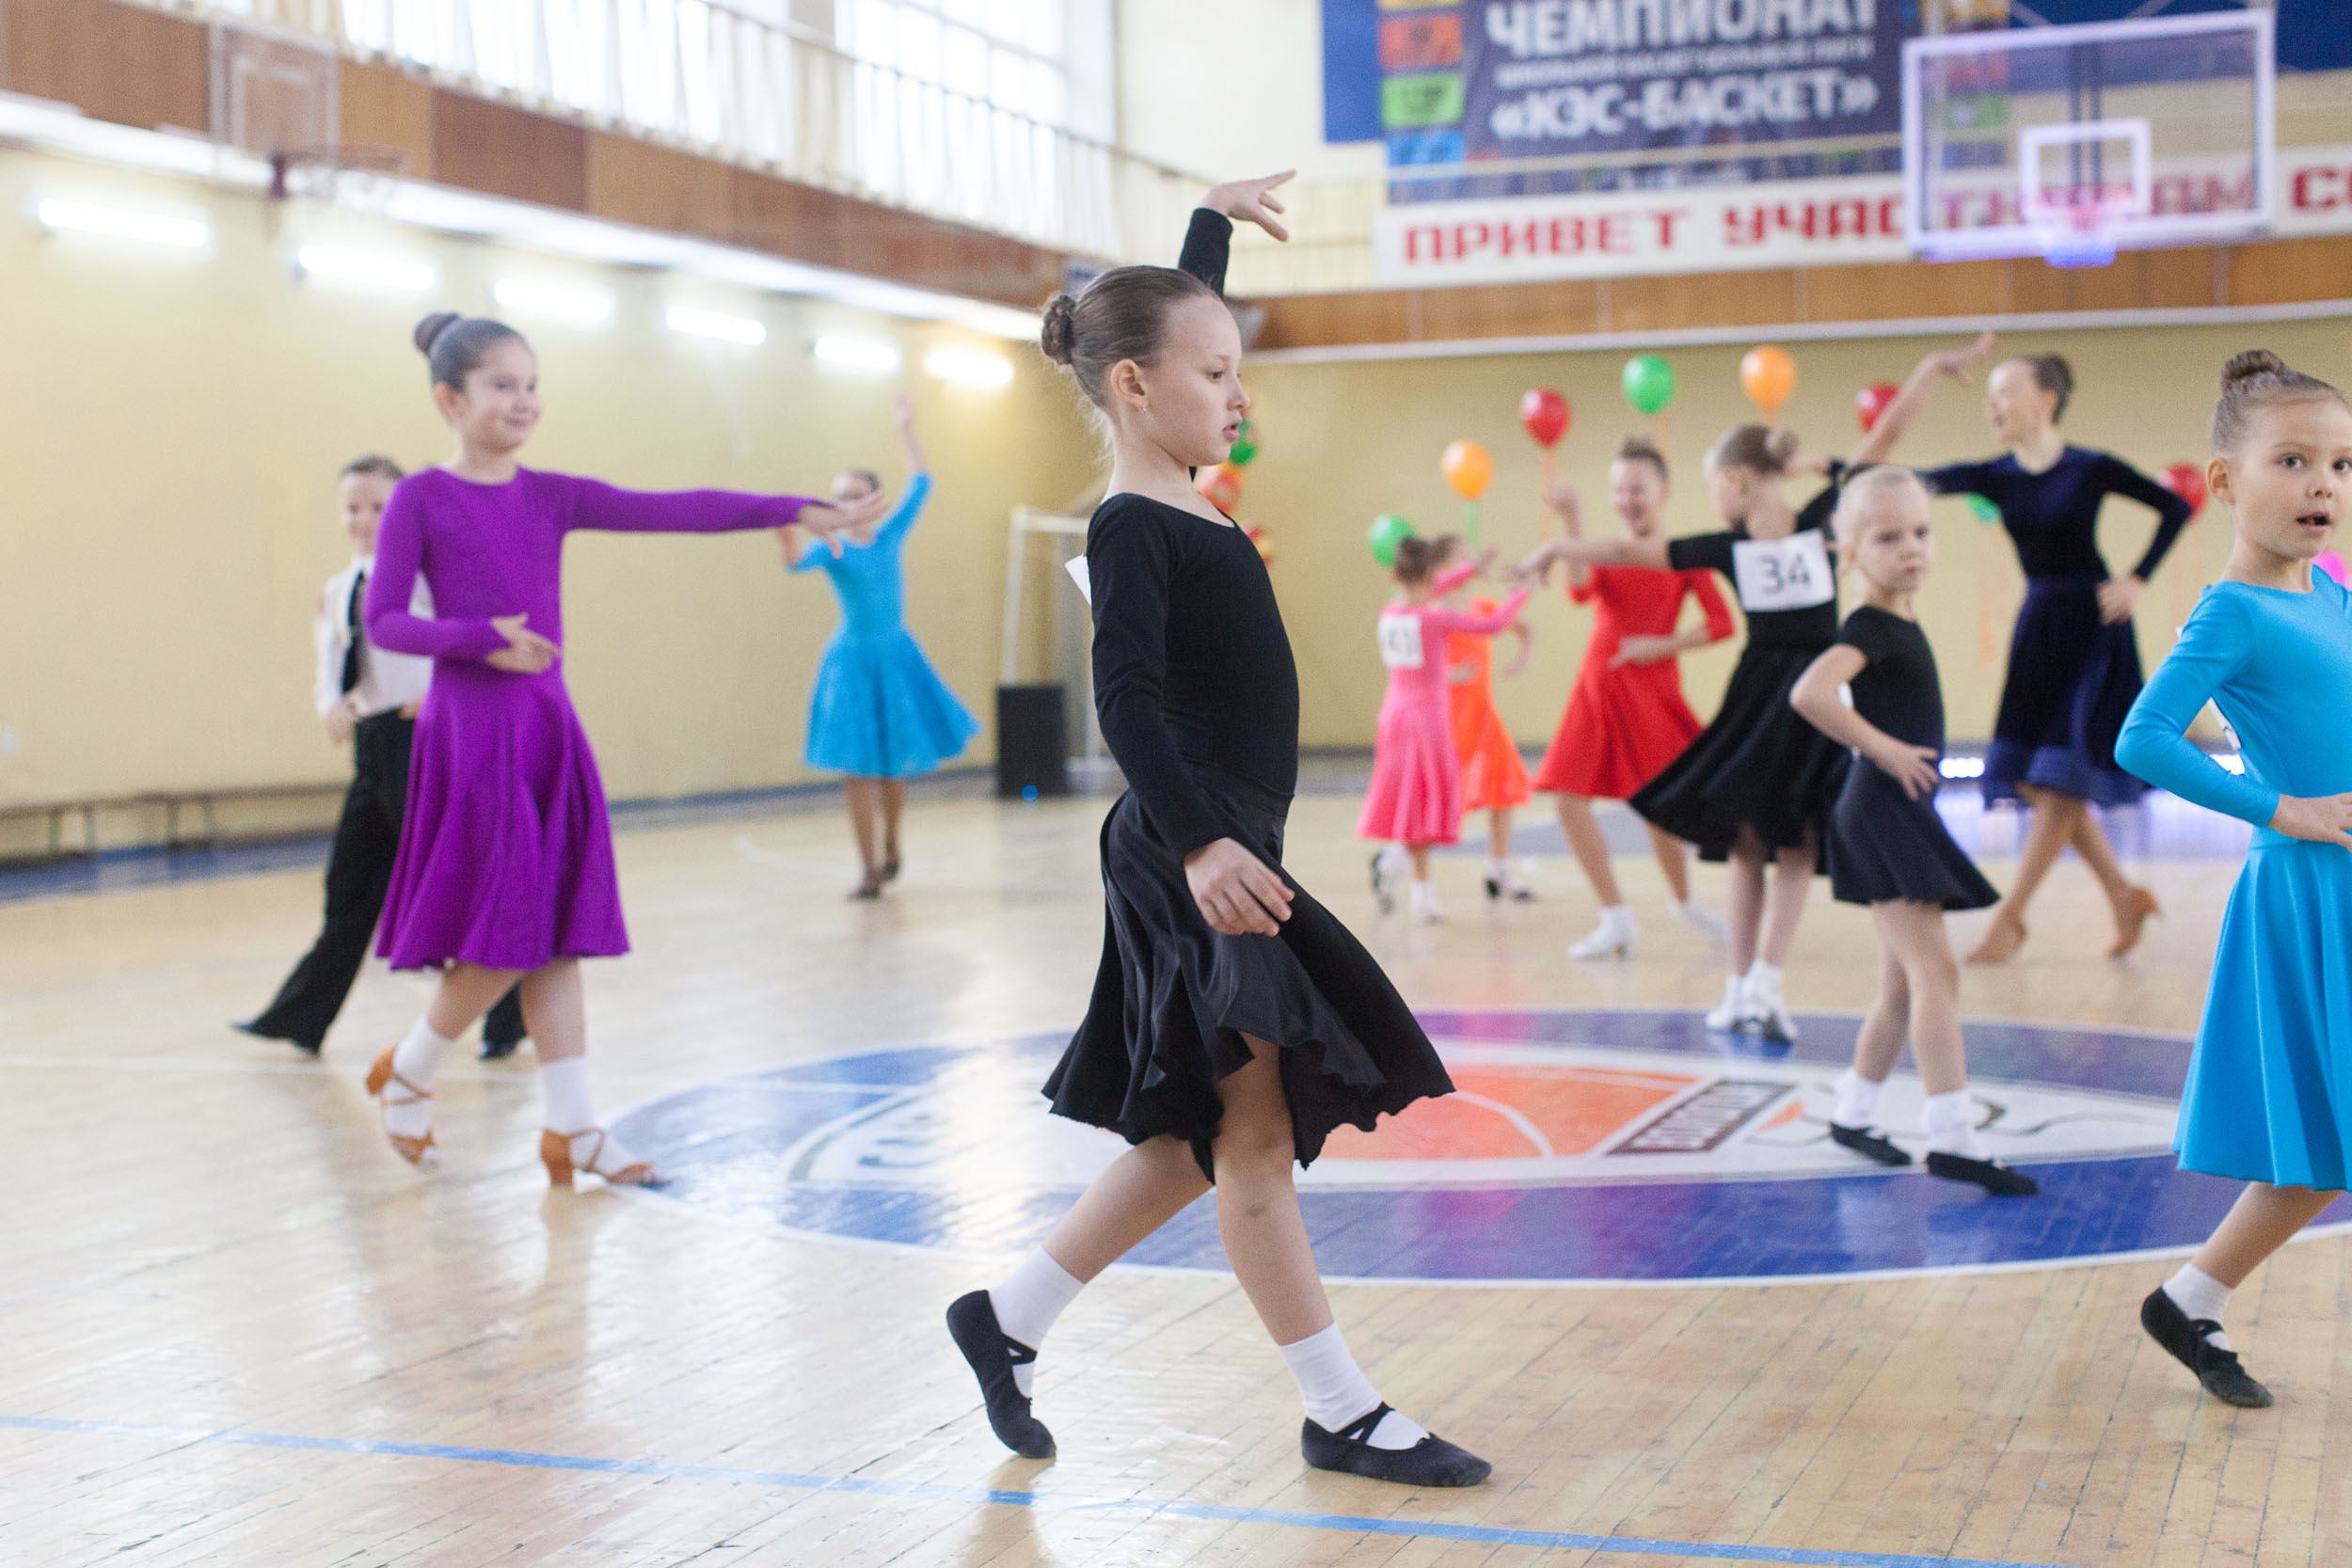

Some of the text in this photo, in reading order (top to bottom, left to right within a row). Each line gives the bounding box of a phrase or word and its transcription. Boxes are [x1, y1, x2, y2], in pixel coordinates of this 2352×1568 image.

[1405, 205, 1690, 264] ПРИВЕТ
[2290, 164, 2352, 214] С
[1758, 551, 1813, 595] 34
